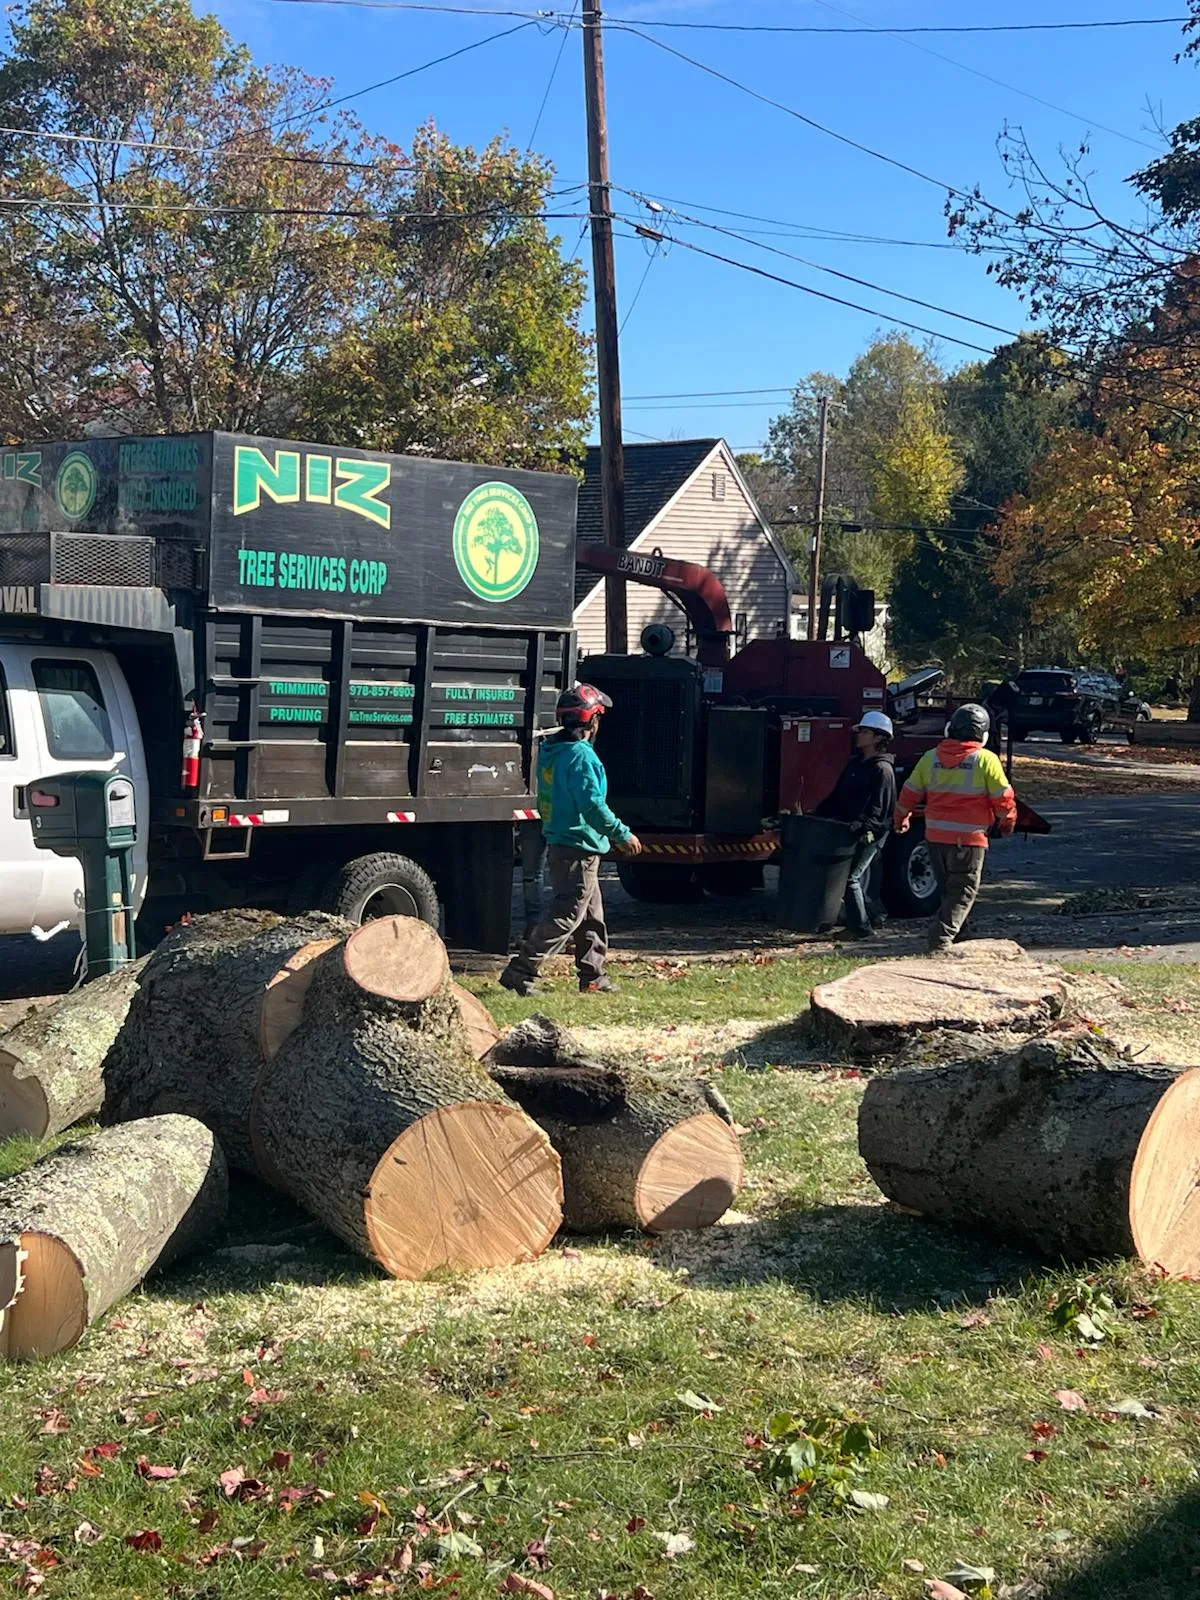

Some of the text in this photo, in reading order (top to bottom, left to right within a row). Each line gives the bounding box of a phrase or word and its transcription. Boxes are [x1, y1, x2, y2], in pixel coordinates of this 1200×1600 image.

[0, 451, 42, 489] IZ
[234, 445, 391, 530] NIZ
[238, 549, 388, 595] TREE SERVICES CORP
[616, 553, 665, 578] BANDIT
[269, 682, 326, 696] TRIMMING
[349, 685, 415, 698] 978-857-6903
[445, 688, 515, 701] FULLY INSURED
[270, 707, 322, 721] PRUNING
[444, 713, 514, 725] FREE ESTIMATES
[36, 816, 42, 828] 3
